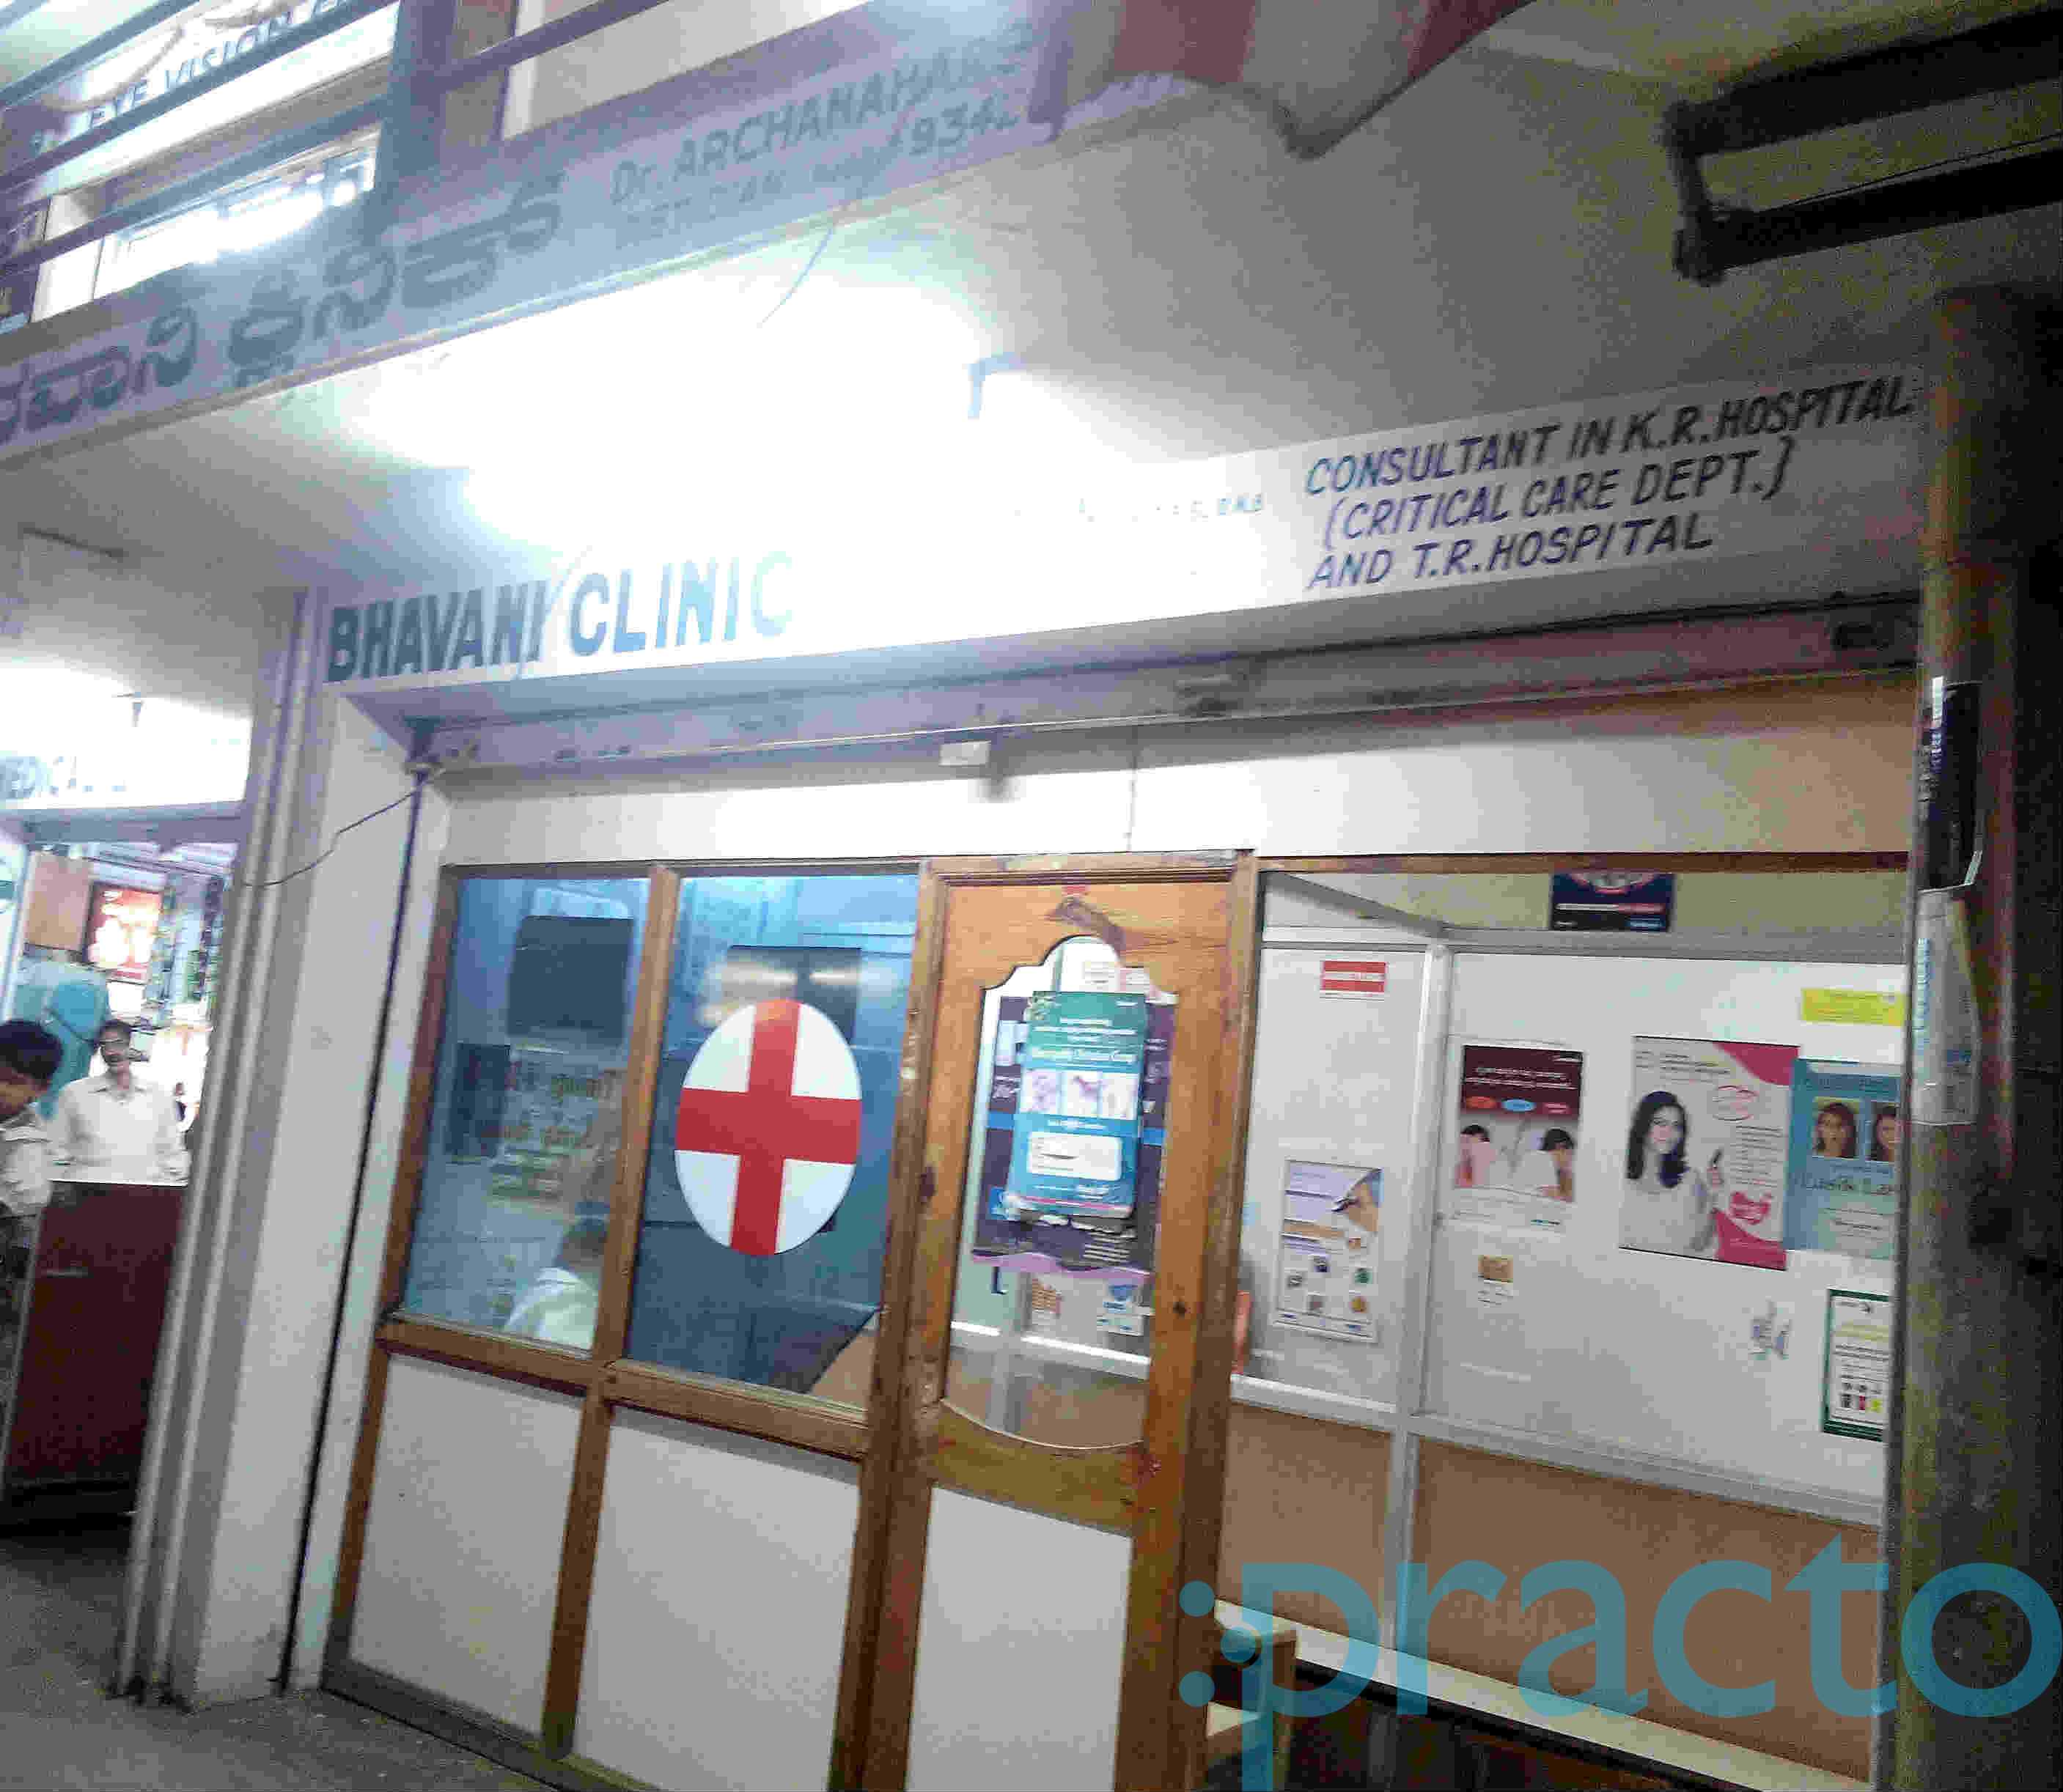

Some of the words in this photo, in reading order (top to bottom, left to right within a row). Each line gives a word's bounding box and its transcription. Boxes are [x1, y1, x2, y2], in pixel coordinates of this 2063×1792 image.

[1304, 421, 1564, 495] CONSULTANT
[1570, 415, 1616, 462] IN
[1323, 481, 1509, 553] (CRITICAL
[1521, 469, 1621, 517] CARE
[1306, 548, 1394, 590] AND
[327, 581, 548, 682] BHAVANI
[568, 550, 794, 657] CLINIC
